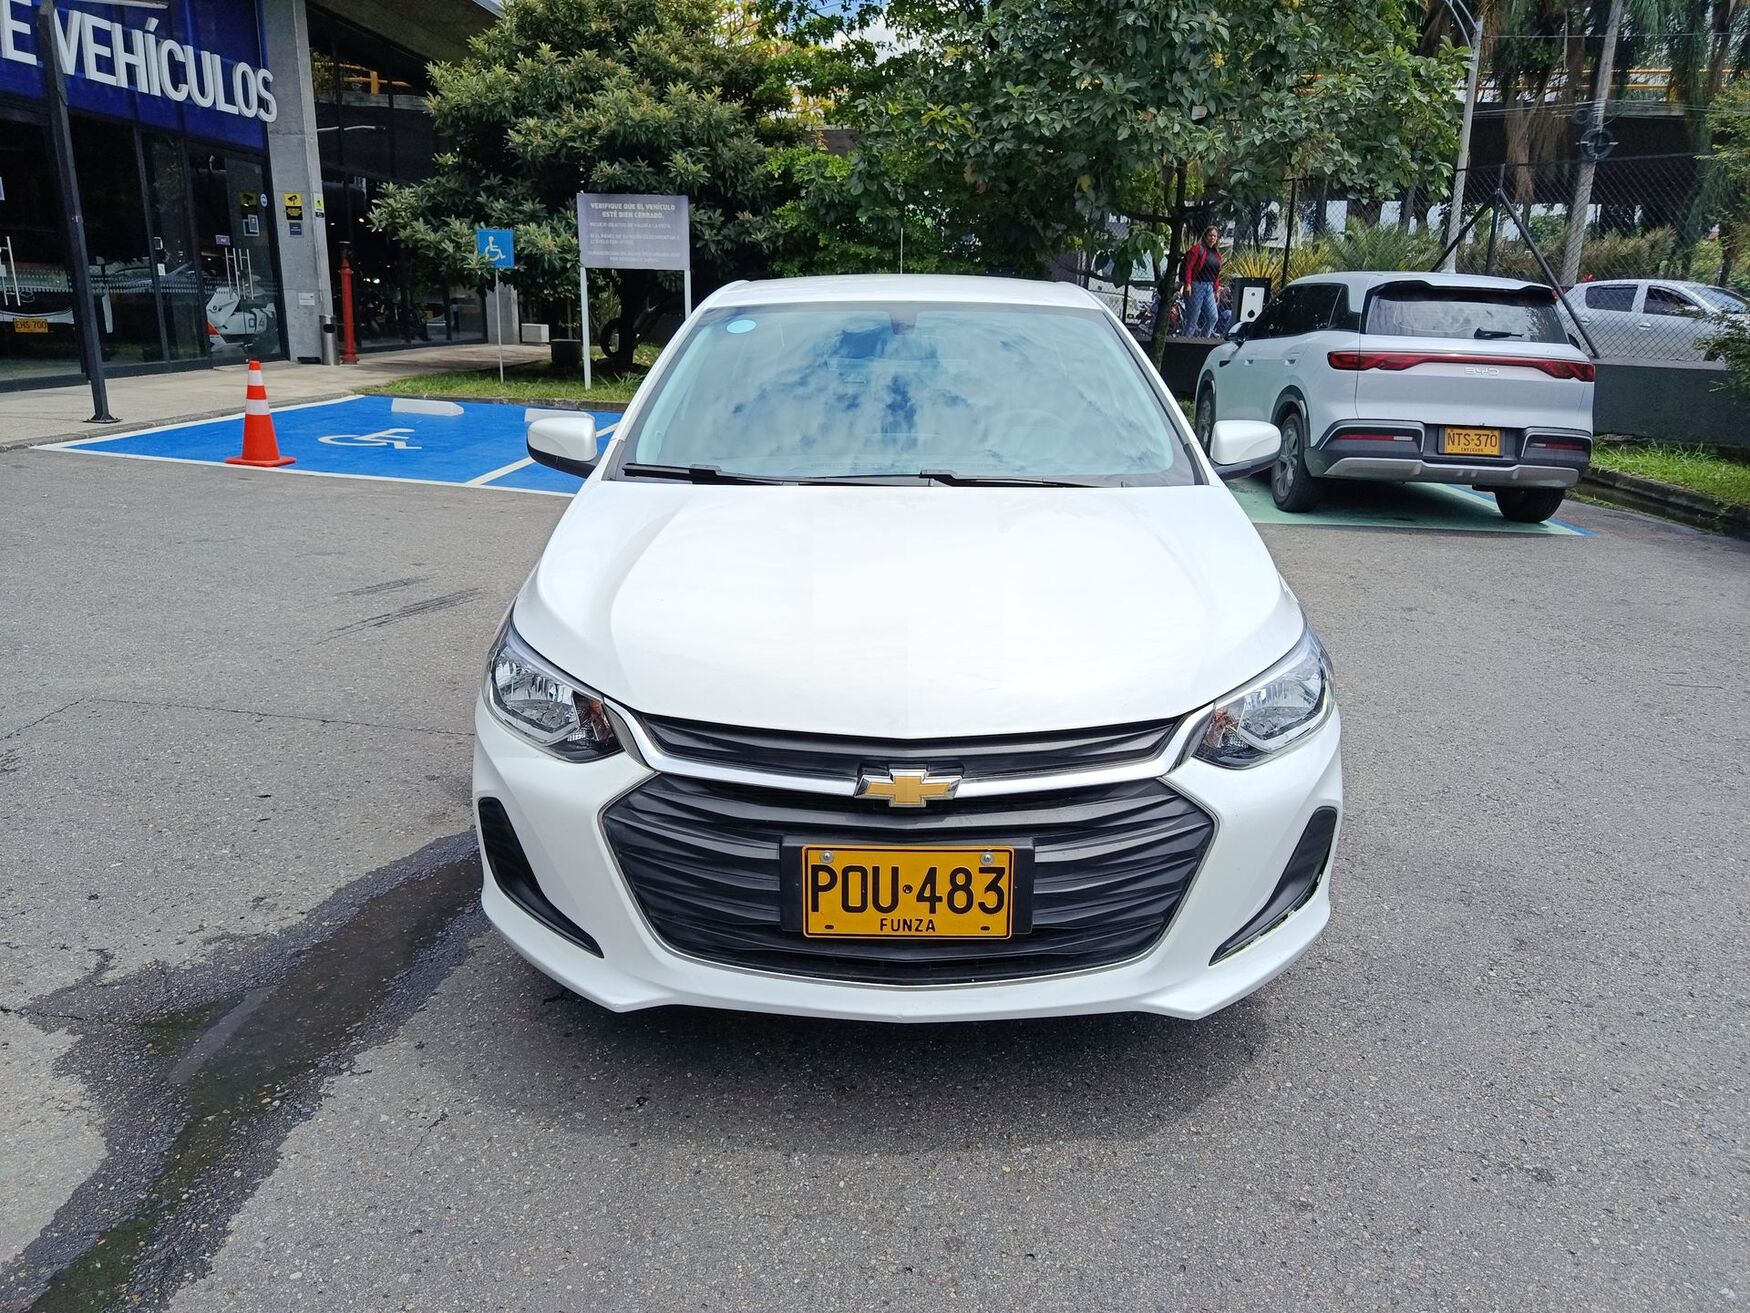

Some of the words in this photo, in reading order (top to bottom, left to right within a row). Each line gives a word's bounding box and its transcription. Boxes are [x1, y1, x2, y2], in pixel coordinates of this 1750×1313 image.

[54, 8, 278, 123] VEHÍCULOS
[590, 202, 622, 210] VERIFIQUE
[645, 202, 676, 211] VEHÍCULO
[1464, 367, 1500, 376] BYD
[880, 917, 936, 932] FUNZA
